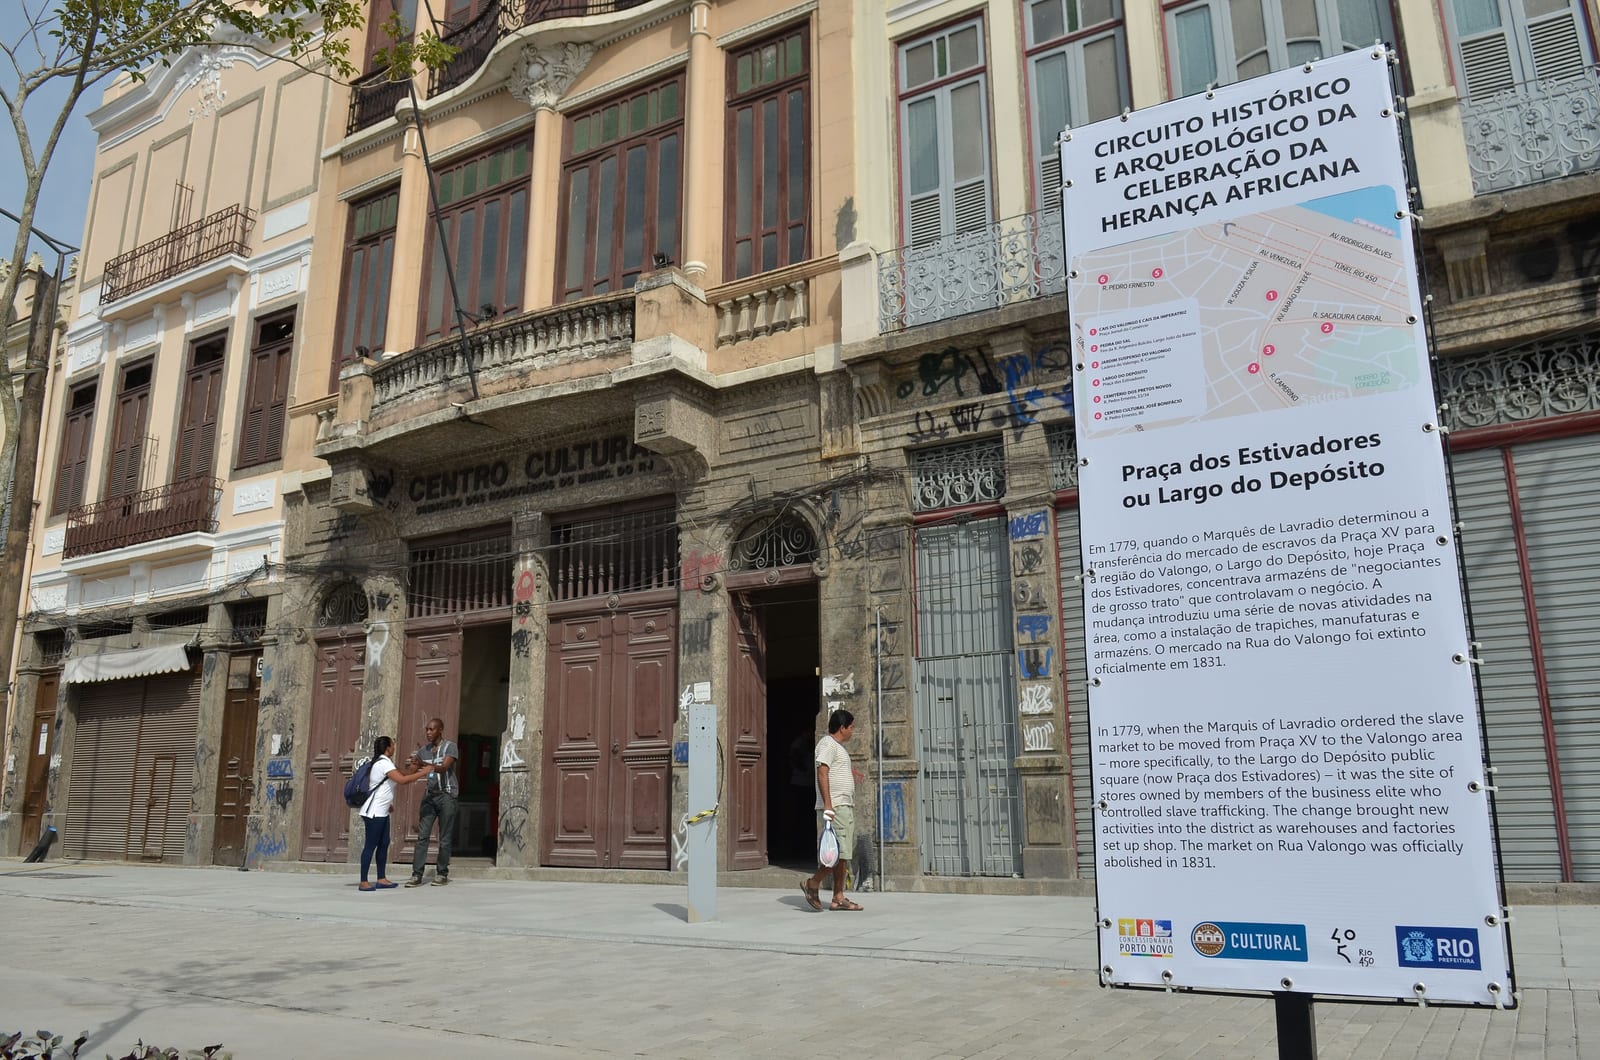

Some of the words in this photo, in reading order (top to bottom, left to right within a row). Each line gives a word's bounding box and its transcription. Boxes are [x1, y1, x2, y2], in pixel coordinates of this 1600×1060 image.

[1094, 116, 1203, 157] CIRCUITO
[1211, 77, 1350, 127] HISTÓRICO
[1094, 166, 1106, 183] E
[1113, 114, 1308, 179] ARQUEOLÓGICO
[1317, 103, 1357, 126] DA
[1123, 148, 1280, 200] CELEBRAÇÃO
[1289, 137, 1328, 160] DA
[1101, 190, 1218, 232] HERANÇA
[1225, 157, 1360, 203] AFRICANA
[1259, 249, 1269, 258] AV.
[1269, 252, 1302, 269] VENEZUELA
[1329, 232, 1339, 241] AV.
[1339, 235, 1373, 252] RODRIGUES
[1373, 247, 1393, 259] ALVES
[1128, 281, 1155, 289] ERNESTO
[1232, 278, 1247, 298] SOUZA
[1247, 260, 1260, 276] SILVA
[1333, 261, 1351, 274] TÚNEL
[1352, 268, 1364, 278] RIO
[1365, 273, 1378, 283] 450
[1312, 311, 1319, 319] R.
[1320, 312, 1355, 321] SACADURA
[1356, 313, 1383, 322] CABRAL
[1269, 372, 1276, 380] R.
[1274, 377, 1299, 402] CAMERINO
[408, 460, 509, 502] CENTRO
[525, 436, 657, 476] CULTURA
[1121, 461, 1181, 482] Praça
[1189, 453, 1230, 472] dos
[1238, 433, 1381, 465] Estivadores
[1122, 493, 1150, 508] ou
[1158, 483, 1223, 504] Largo
[1230, 474, 1261, 494] do
[1269, 460, 1384, 490] Depósito
[1089, 544, 1105, 554] Em
[1109, 539, 1139, 552] 1779,
[1142, 534, 1188, 550] quando
[1191, 534, 1199, 542] o
[1203, 526, 1255, 541] Marquês
[1259, 524, 1275, 535] de
[1279, 517, 1334, 533] Lavradio
[1338, 510, 1416, 526] determinou
[1421, 508, 1429, 517] a
[1089, 552, 1162, 568] transferência
[1165, 550, 1181, 561] do
[1185, 543, 1238, 558] mercado
[1242, 541, 1257, 552] de
[1261, 537, 1316, 550] escravos
[1320, 532, 1336, 544] da
[1340, 530, 1376, 542] Praça
[1380, 525, 1399, 538] XV
[1404, 524, 1434, 538] para
[1090, 587, 1111, 598] dos
[1114, 582, 1182, 596] Estivadores,
[1186, 575, 1260, 589] concentrava
[1264, 567, 1326, 582] armazéns
[1330, 564, 1347, 576] de
[1351, 557, 1441, 575] "negociantes
[1100, 570, 1137, 584] região
[1139, 568, 1154, 579] do
[1157, 564, 1211, 576] Valongo,
[1214, 563, 1223, 571] o
[1227, 559, 1262, 571] Largo
[1266, 554, 1283, 566] do
[1287, 548, 1349, 565] Depósito,
[1353, 544, 1383, 559] hoje
[1387, 542, 1424, 554] Praça
[1097, 726, 1108, 736] In
[1112, 724, 1143, 736] 1779,
[1146, 723, 1179, 735] when
[1183, 722, 1203, 733] the
[1207, 719, 1258, 734] Marquis
[1261, 718, 1275, 730] of
[1279, 716, 1336, 729] Lavradio
[1340, 713, 1395, 727] ordered
[1399, 713, 1423, 725] the
[1427, 711, 1463, 724] slave
[1099, 775, 1139, 787] square
[1143, 773, 1172, 785] (now
[1176, 772, 1210, 785] Praça
[1214, 770, 1237, 782] dos
[1241, 769, 1320, 782] Estivadores)
[1336, 768, 1346, 780] it
[1349, 770, 1377, 779] was
[1381, 767, 1404, 779] the
[1408, 766, 1434, 778] site
[1439, 765, 1453, 778] of
[1119, 943, 1148, 954] PORTO
[1149, 943, 1174, 955] NOVO
[1231, 932, 1301, 951] CULTURAL
[1437, 937, 1474, 958] RIO
[1358, 957, 1375, 968] 450
